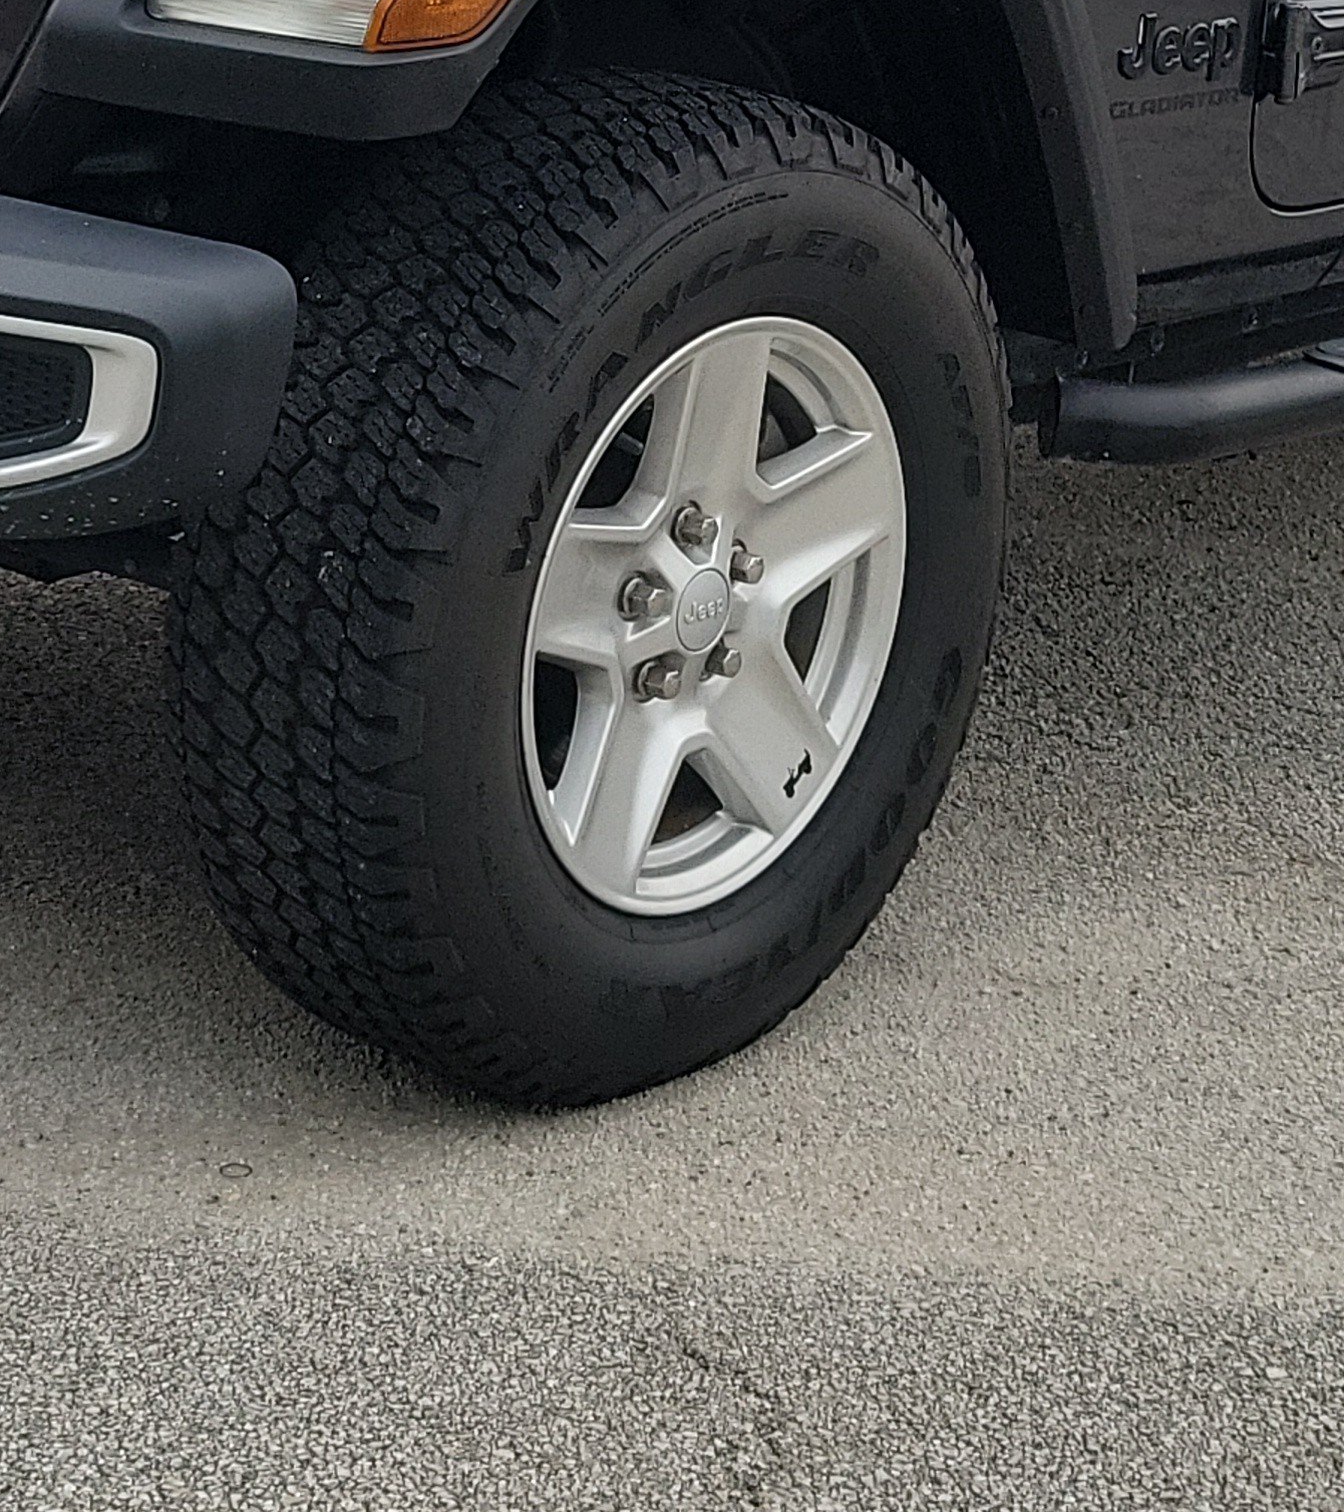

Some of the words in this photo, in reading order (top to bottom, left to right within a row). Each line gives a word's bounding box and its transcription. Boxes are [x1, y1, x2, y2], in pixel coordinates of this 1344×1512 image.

[1117, 11, 1241, 81] Jeep
[1109, 87, 1240, 120] GLADIATOR
[503, 225, 882, 574] WRANGLER
[683, 596, 724, 626] Jeep
